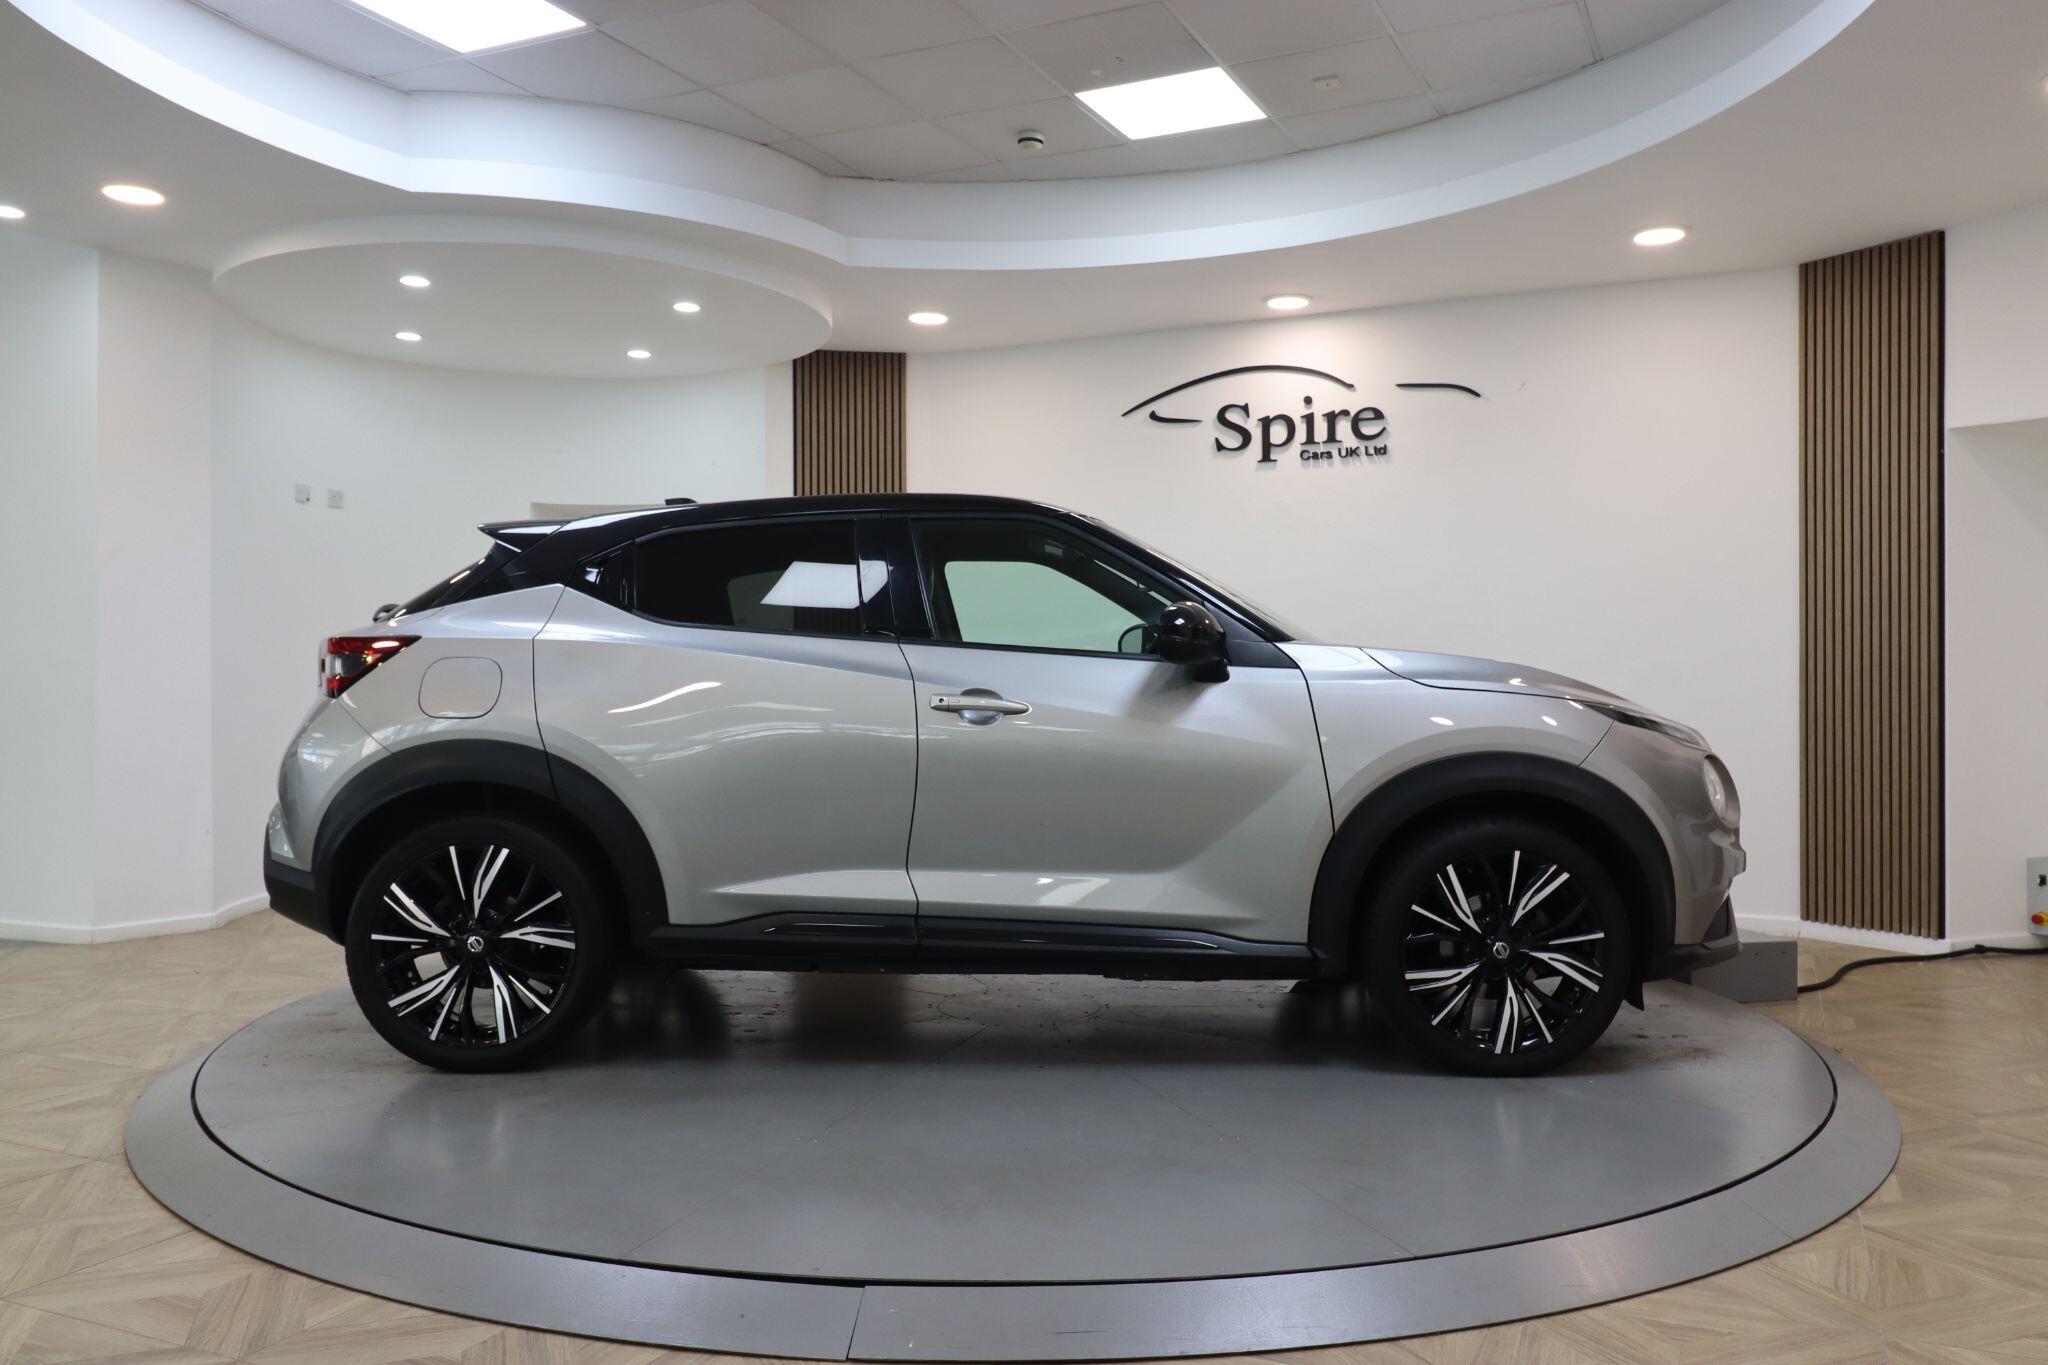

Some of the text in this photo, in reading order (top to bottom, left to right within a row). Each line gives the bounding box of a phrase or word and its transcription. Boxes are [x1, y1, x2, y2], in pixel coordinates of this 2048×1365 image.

[1214, 395, 1386, 463] Spire
[1300, 444, 1387, 461] Cars UK Ltd
